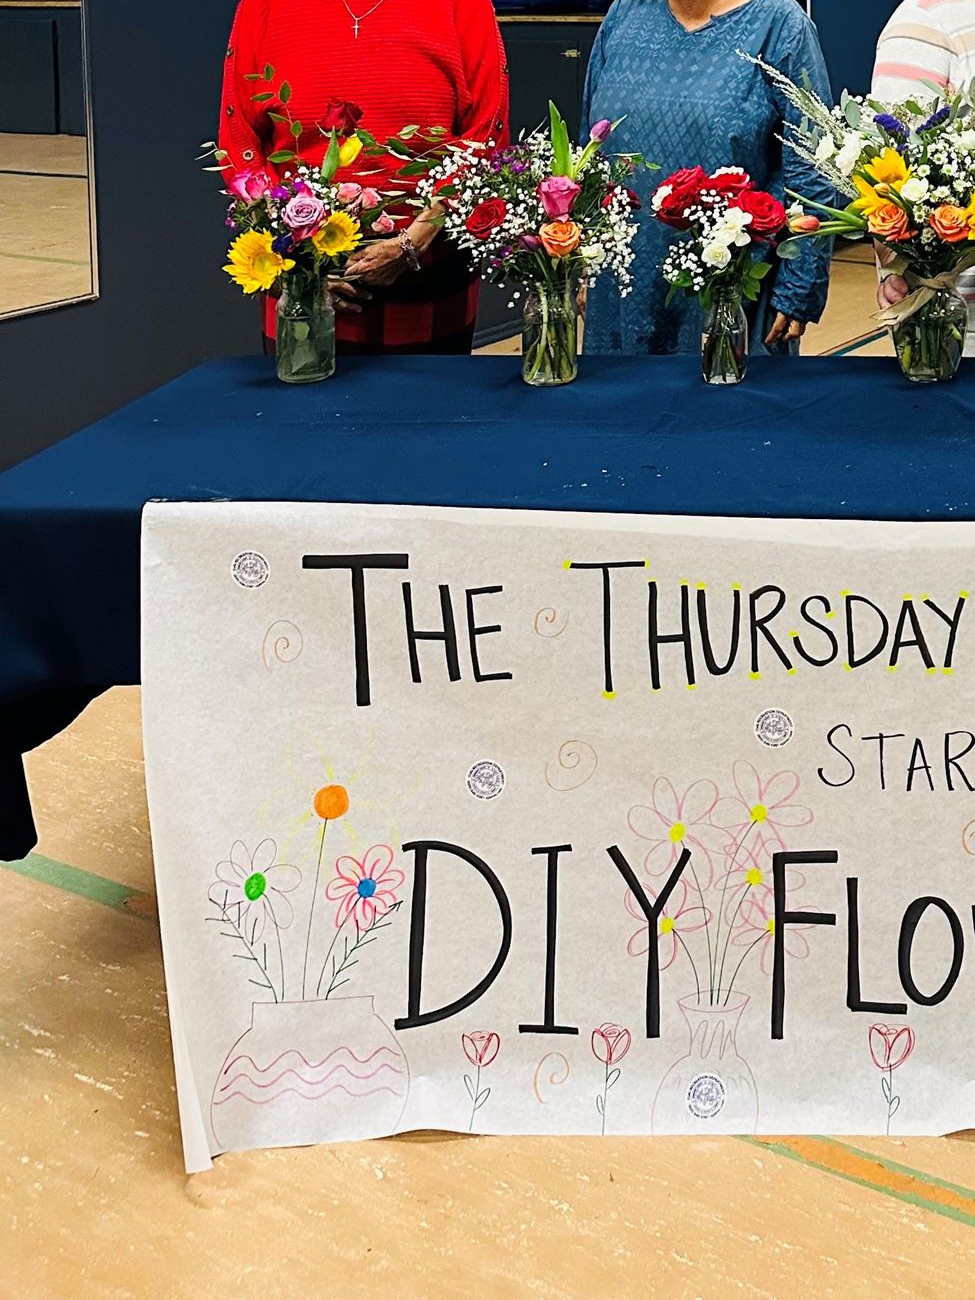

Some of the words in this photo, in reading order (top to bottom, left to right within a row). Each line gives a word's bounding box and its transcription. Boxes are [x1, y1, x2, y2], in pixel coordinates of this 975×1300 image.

[302, 554, 513, 707] THE
[568, 561, 967, 694] THURSDAY
[394, 840, 692, 1039] DIY
